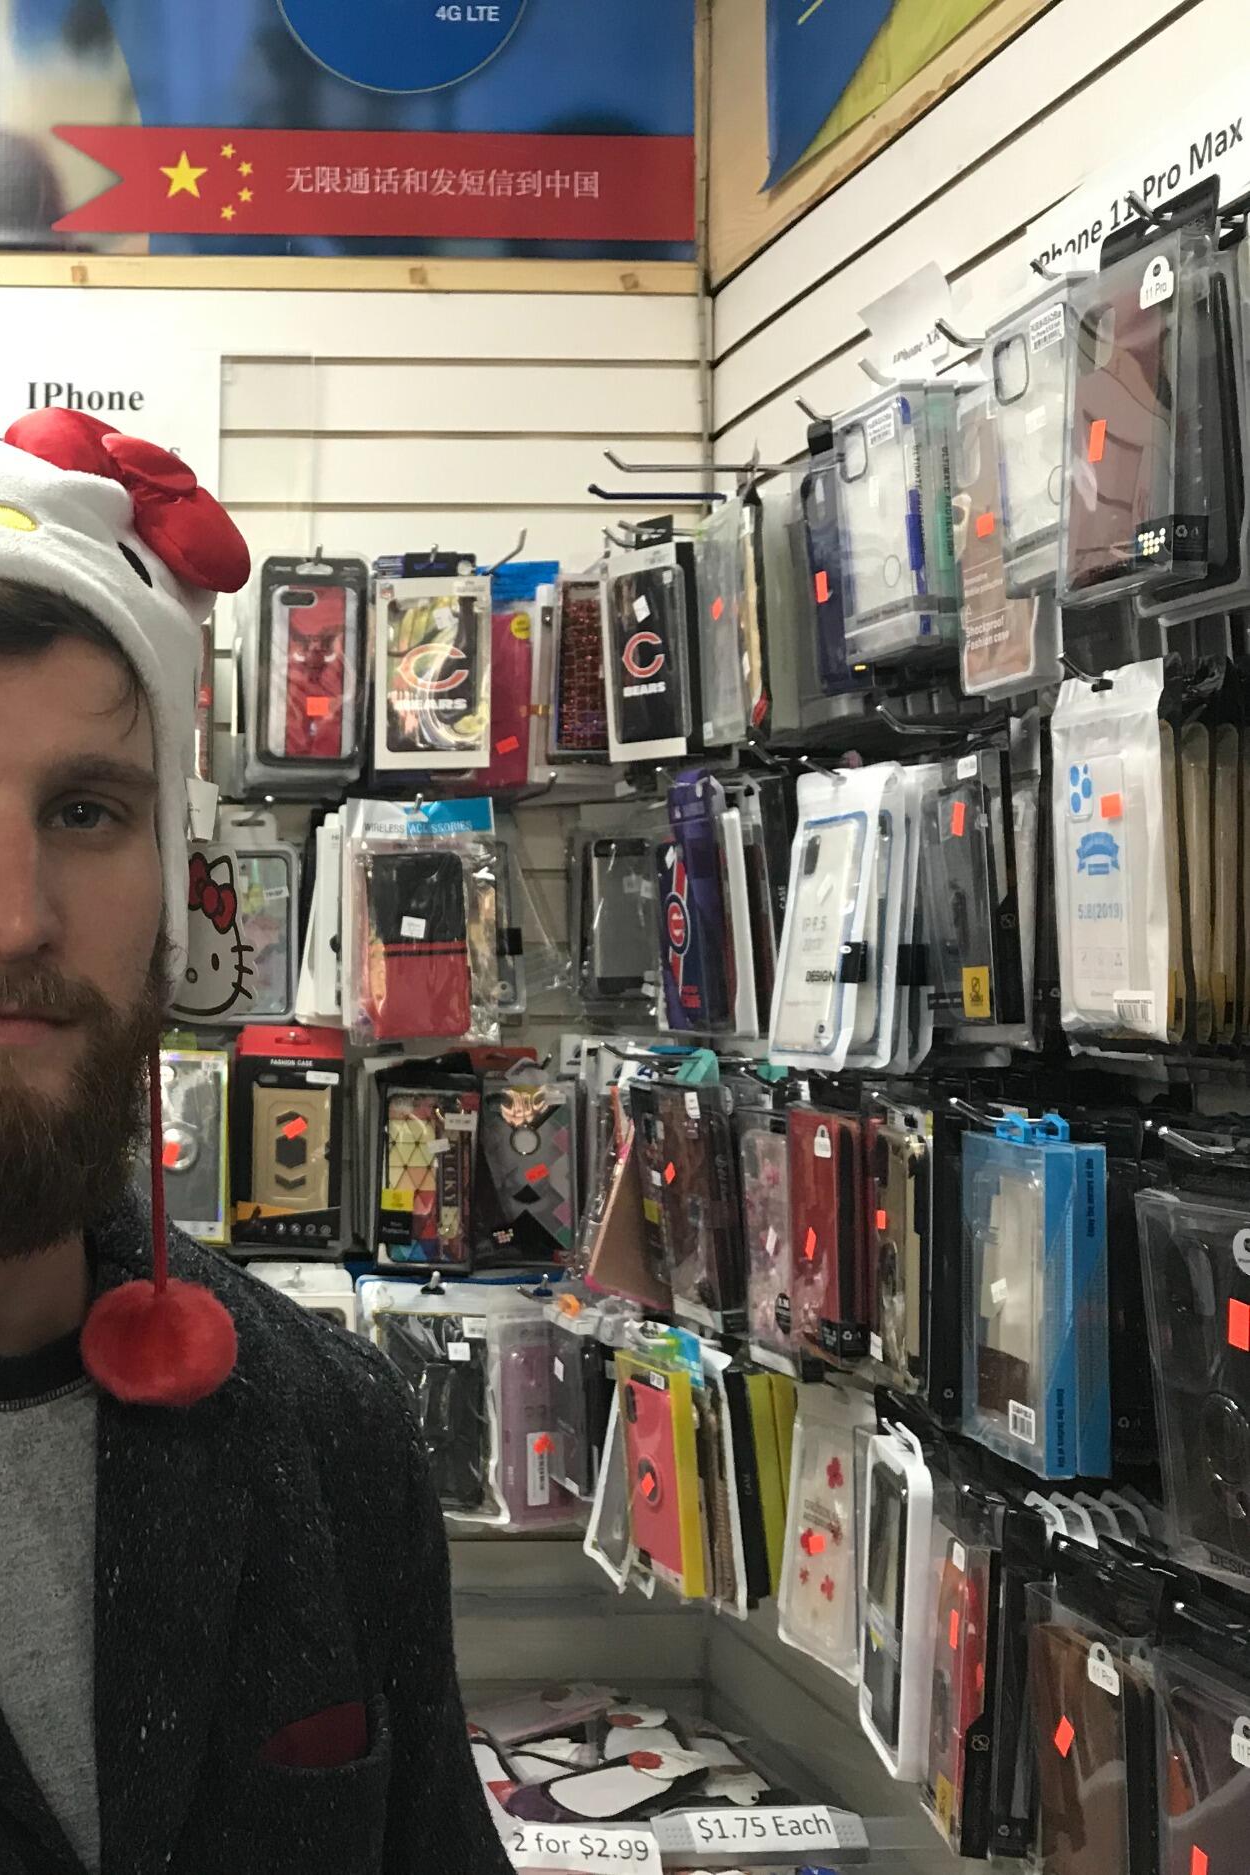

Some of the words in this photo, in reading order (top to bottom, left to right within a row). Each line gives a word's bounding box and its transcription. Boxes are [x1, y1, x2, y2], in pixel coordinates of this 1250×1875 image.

[435, 5, 462, 21] 4G
[466, 5, 500, 22] LTE
[1143, 163, 1181, 204] Pro
[1189, 117, 1243, 176] Max
[286, 165, 600, 199] 无限通话和发短信到中国
[26, 382, 144, 411] IPhone
[364, 822, 405, 834] WIRELESS
[805, 970, 836, 983] DESIGN
[697, 1817, 767, 1841] $1.75
[775, 1816, 831, 1838] Each
[513, 1831, 527, 1852] 2
[534, 1834, 572, 1854] for
[578, 1836, 650, 1861] $2.99
